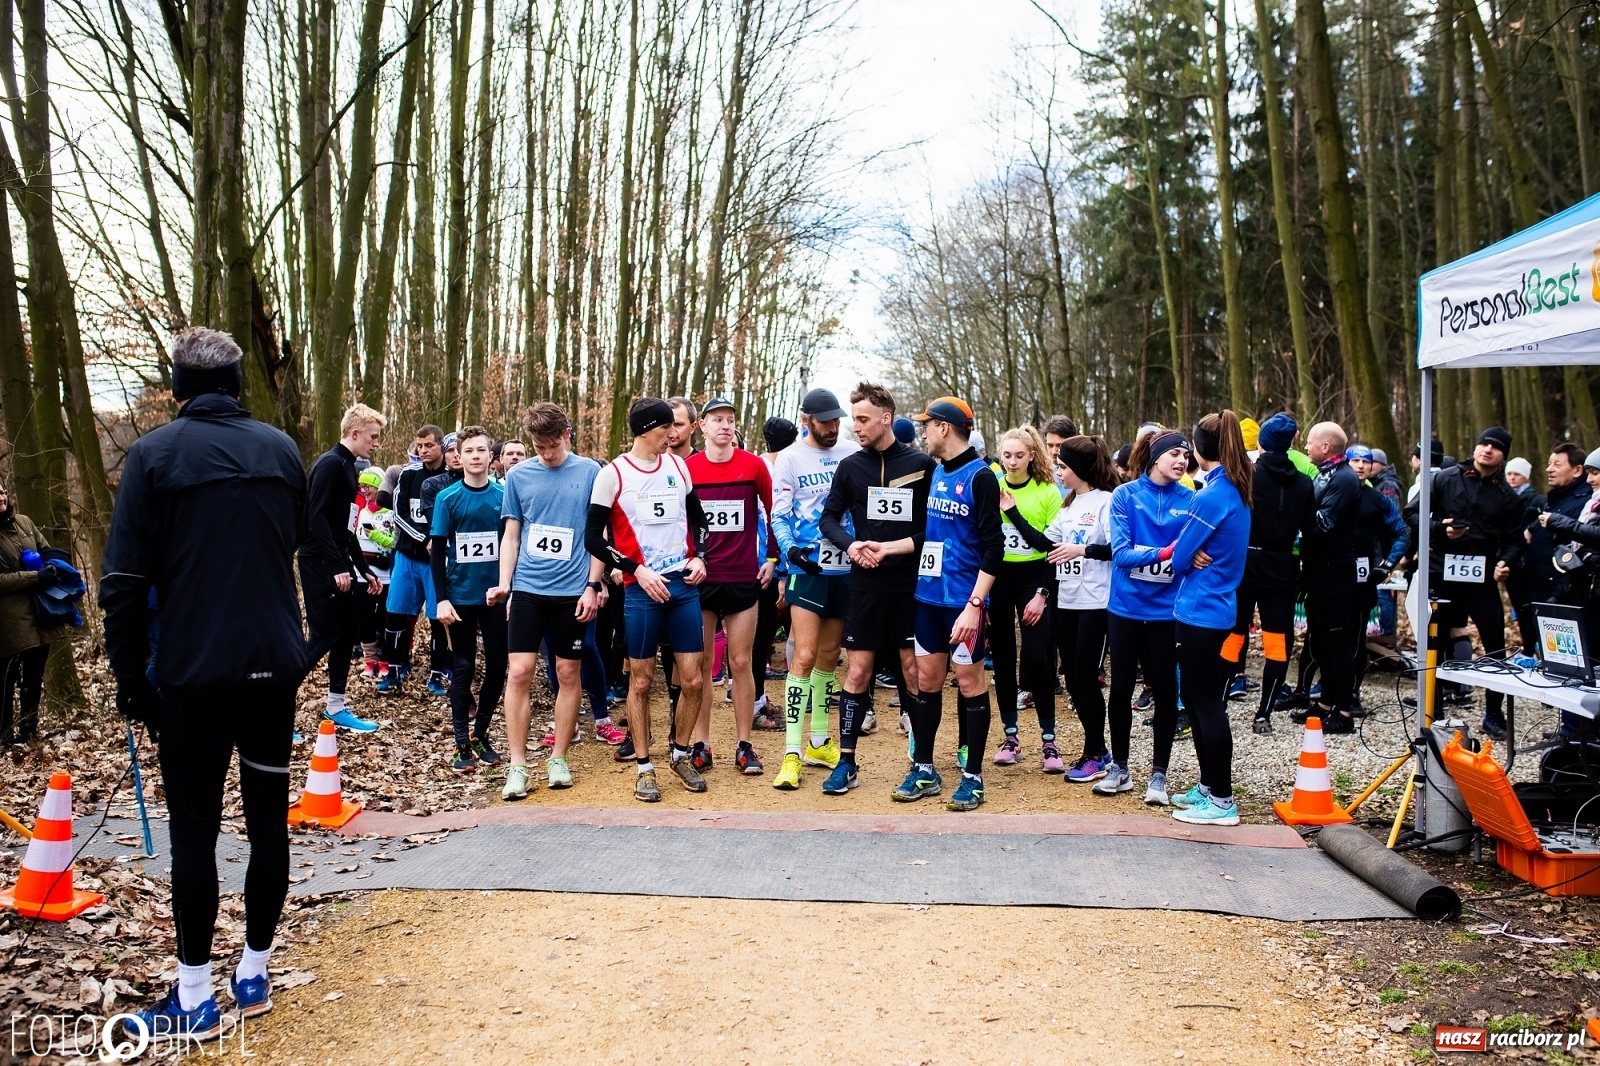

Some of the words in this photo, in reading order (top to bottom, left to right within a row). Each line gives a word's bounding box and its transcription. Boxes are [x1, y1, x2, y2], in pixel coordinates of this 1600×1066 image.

[653, 502, 665, 517] 5
[877, 499, 903, 515] 35
[705, 511, 740, 526] 281
[459, 542, 494, 557] 121
[536, 536, 563, 554] 49
[921, 553, 935, 570] 29
[1447, 564, 1482, 577] 156
